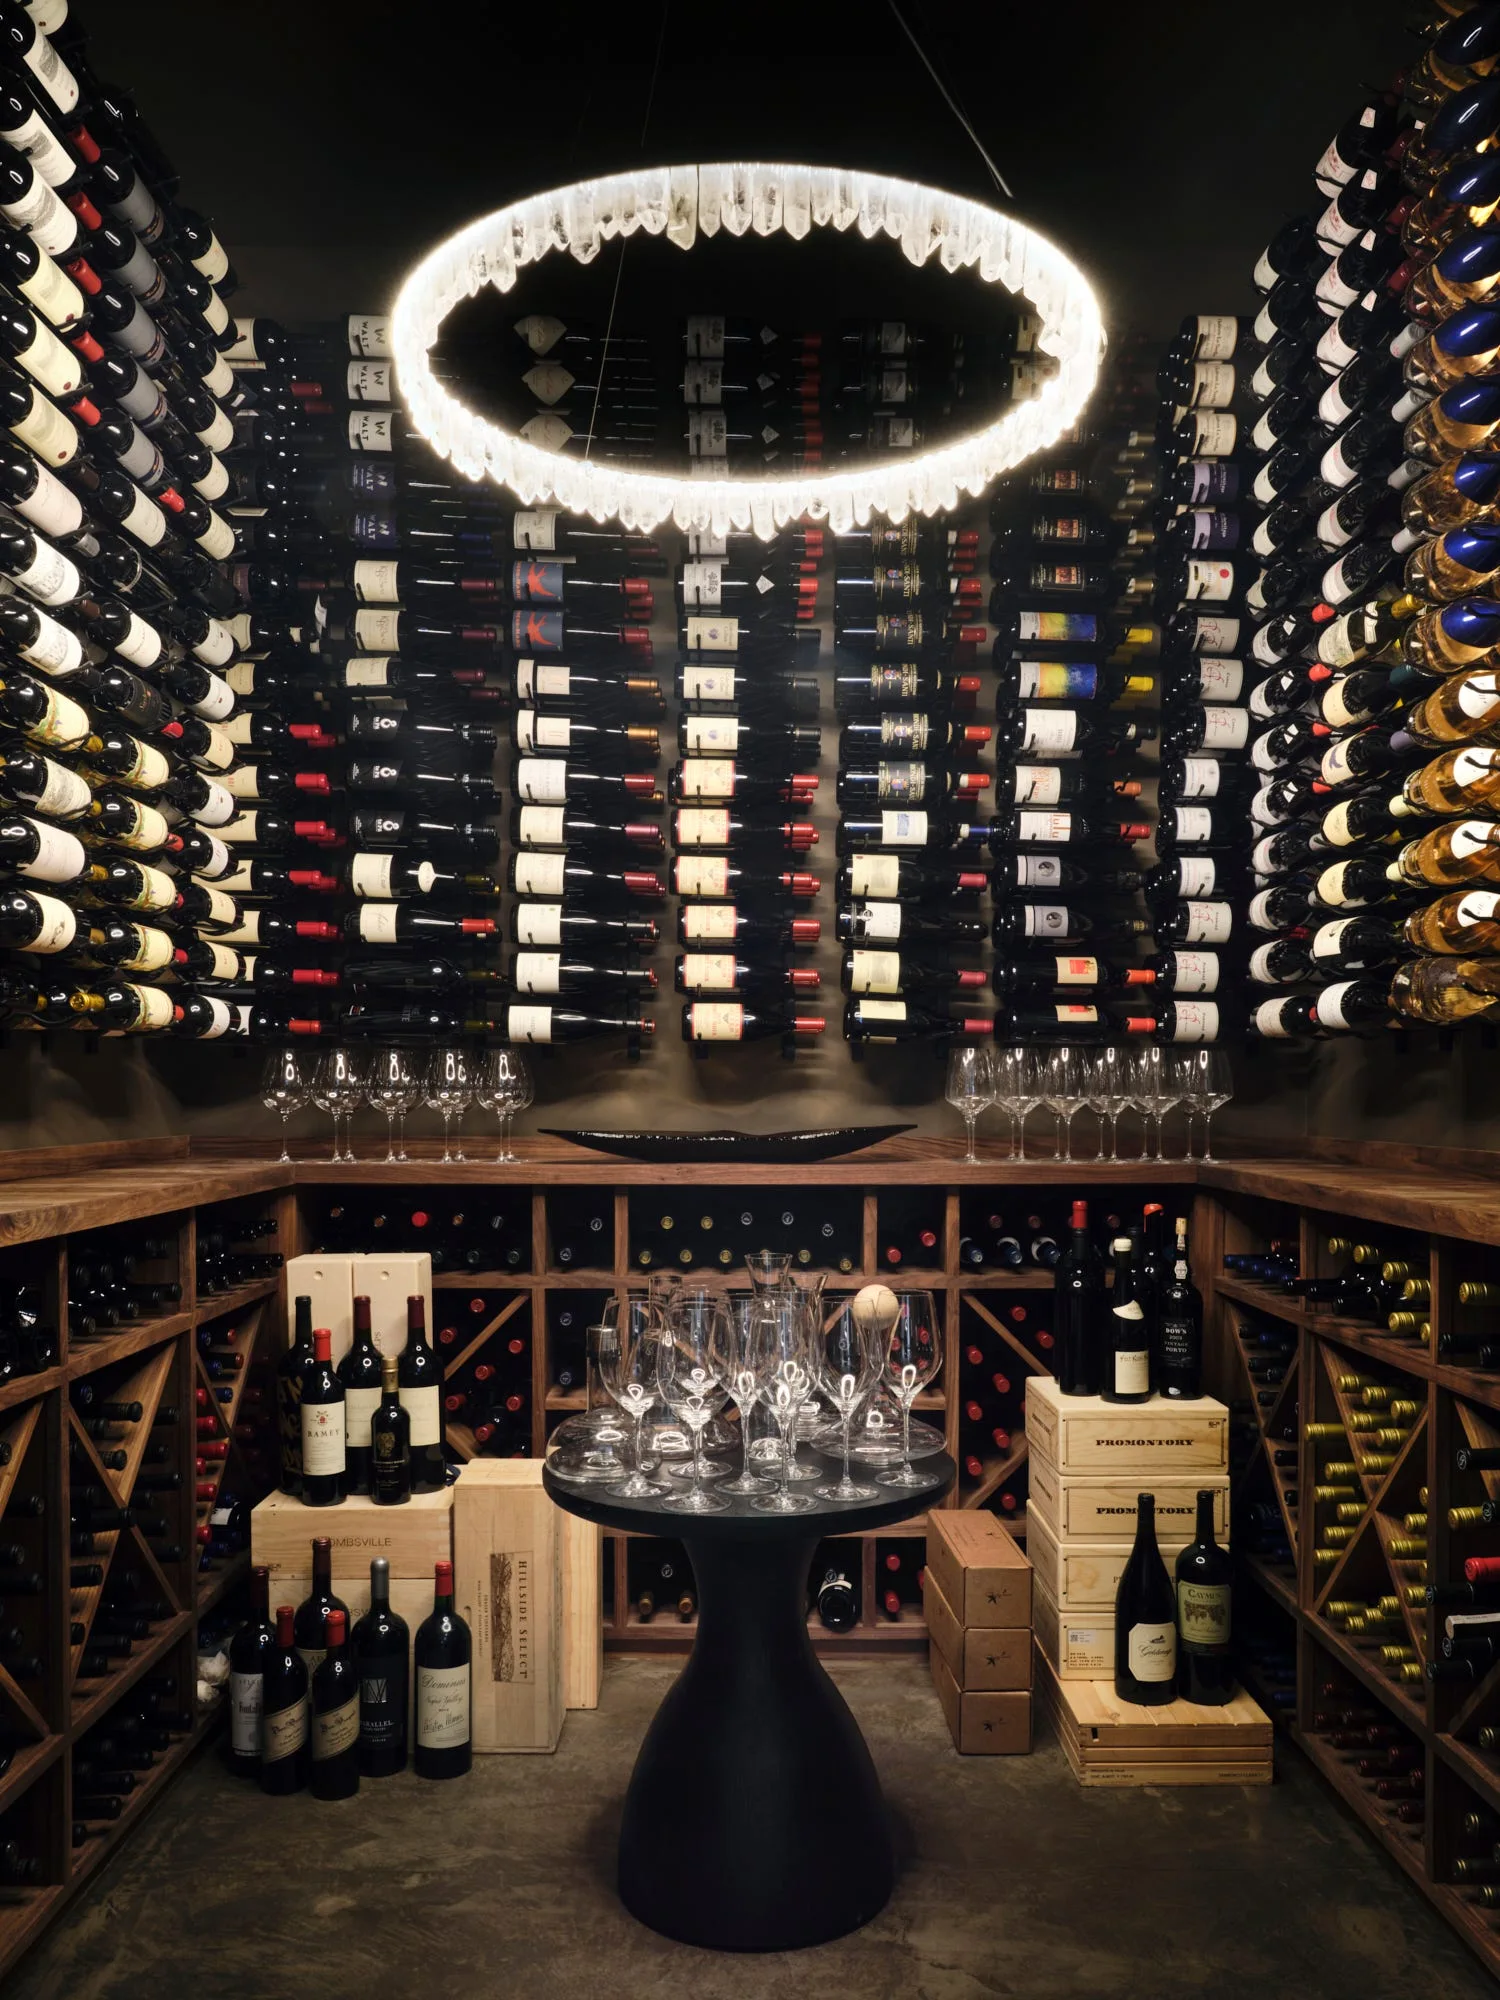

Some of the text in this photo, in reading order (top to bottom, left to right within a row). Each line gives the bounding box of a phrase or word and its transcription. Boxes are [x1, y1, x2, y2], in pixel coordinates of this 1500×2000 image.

[361, 321, 370, 349] WALT
[360, 365, 369, 391] WALT
[361, 415, 370, 441] WALT
[366, 464, 374, 491] WALT
[367, 514, 376, 540] WALT
[1165, 1327, 1187, 1335] DOW'S
[307, 1429, 340, 1438] RAMEY
[1096, 1507, 1196, 1515] PROMTORY
[309, 1537, 392, 1547] COMBSVILLE
[518, 1561, 528, 1622] HILLSIDE
